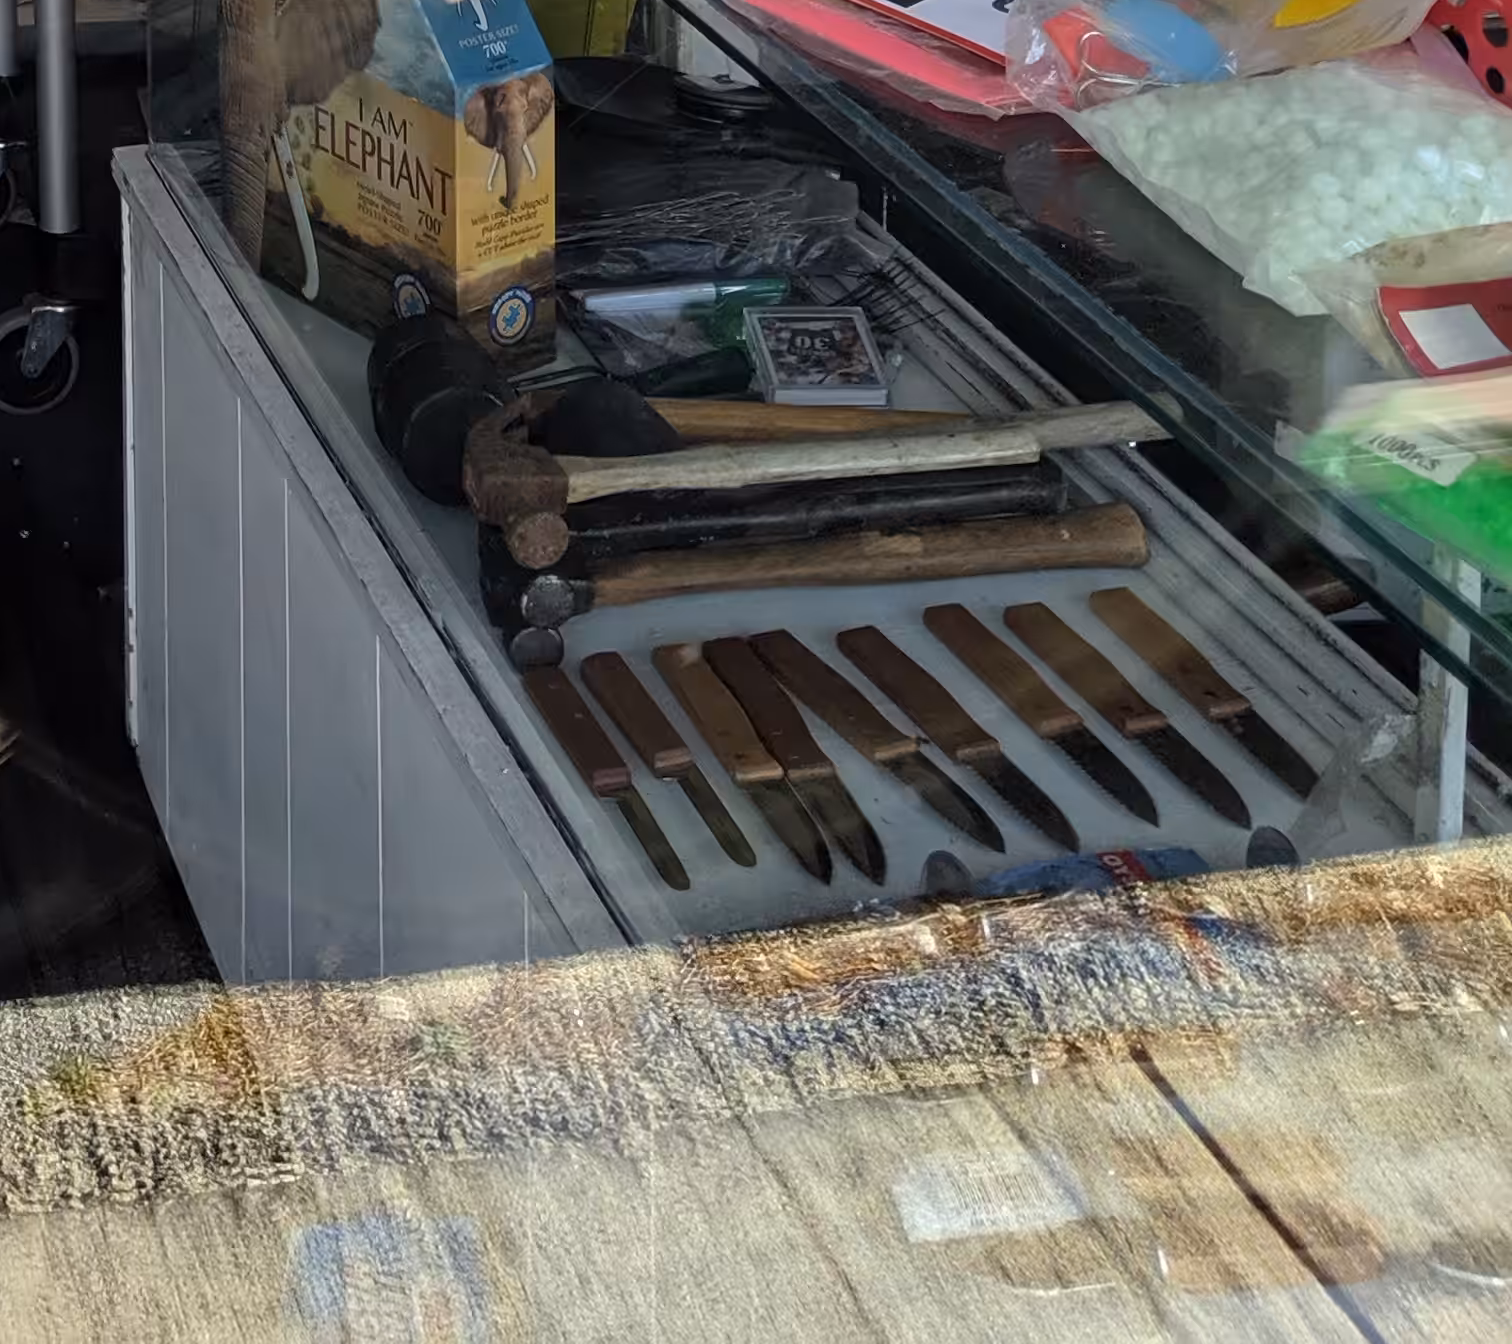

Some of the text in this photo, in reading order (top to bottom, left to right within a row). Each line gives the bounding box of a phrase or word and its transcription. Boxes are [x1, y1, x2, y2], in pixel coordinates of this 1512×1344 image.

[483, 41, 506, 59] 700
[359, 97, 407, 145] I AM
[313, 104, 453, 217] ELEPHANT
[417, 208, 442, 236] 700
